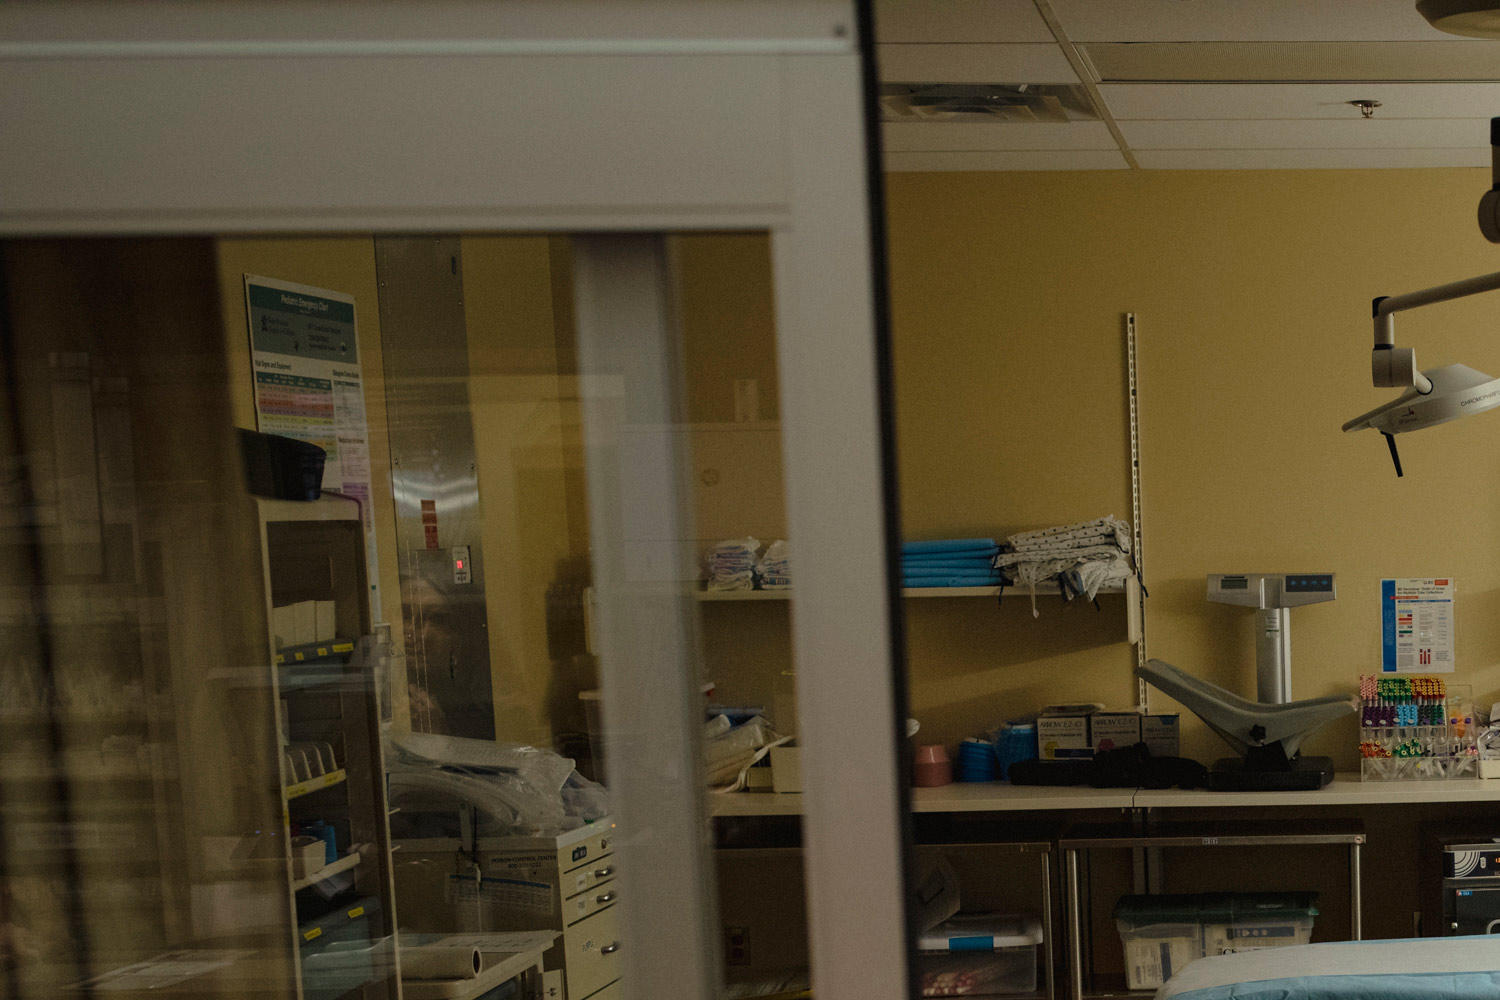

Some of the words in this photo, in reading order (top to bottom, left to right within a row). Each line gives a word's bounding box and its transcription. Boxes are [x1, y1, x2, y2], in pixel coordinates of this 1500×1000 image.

[299, 298, 318, 312] Emergency
[319, 301, 329, 312] Chart
[1039, 721, 1061, 729] ARROW
[1094, 718, 1116, 726] ARROW
[513, 855, 537, 863] CONTROL
